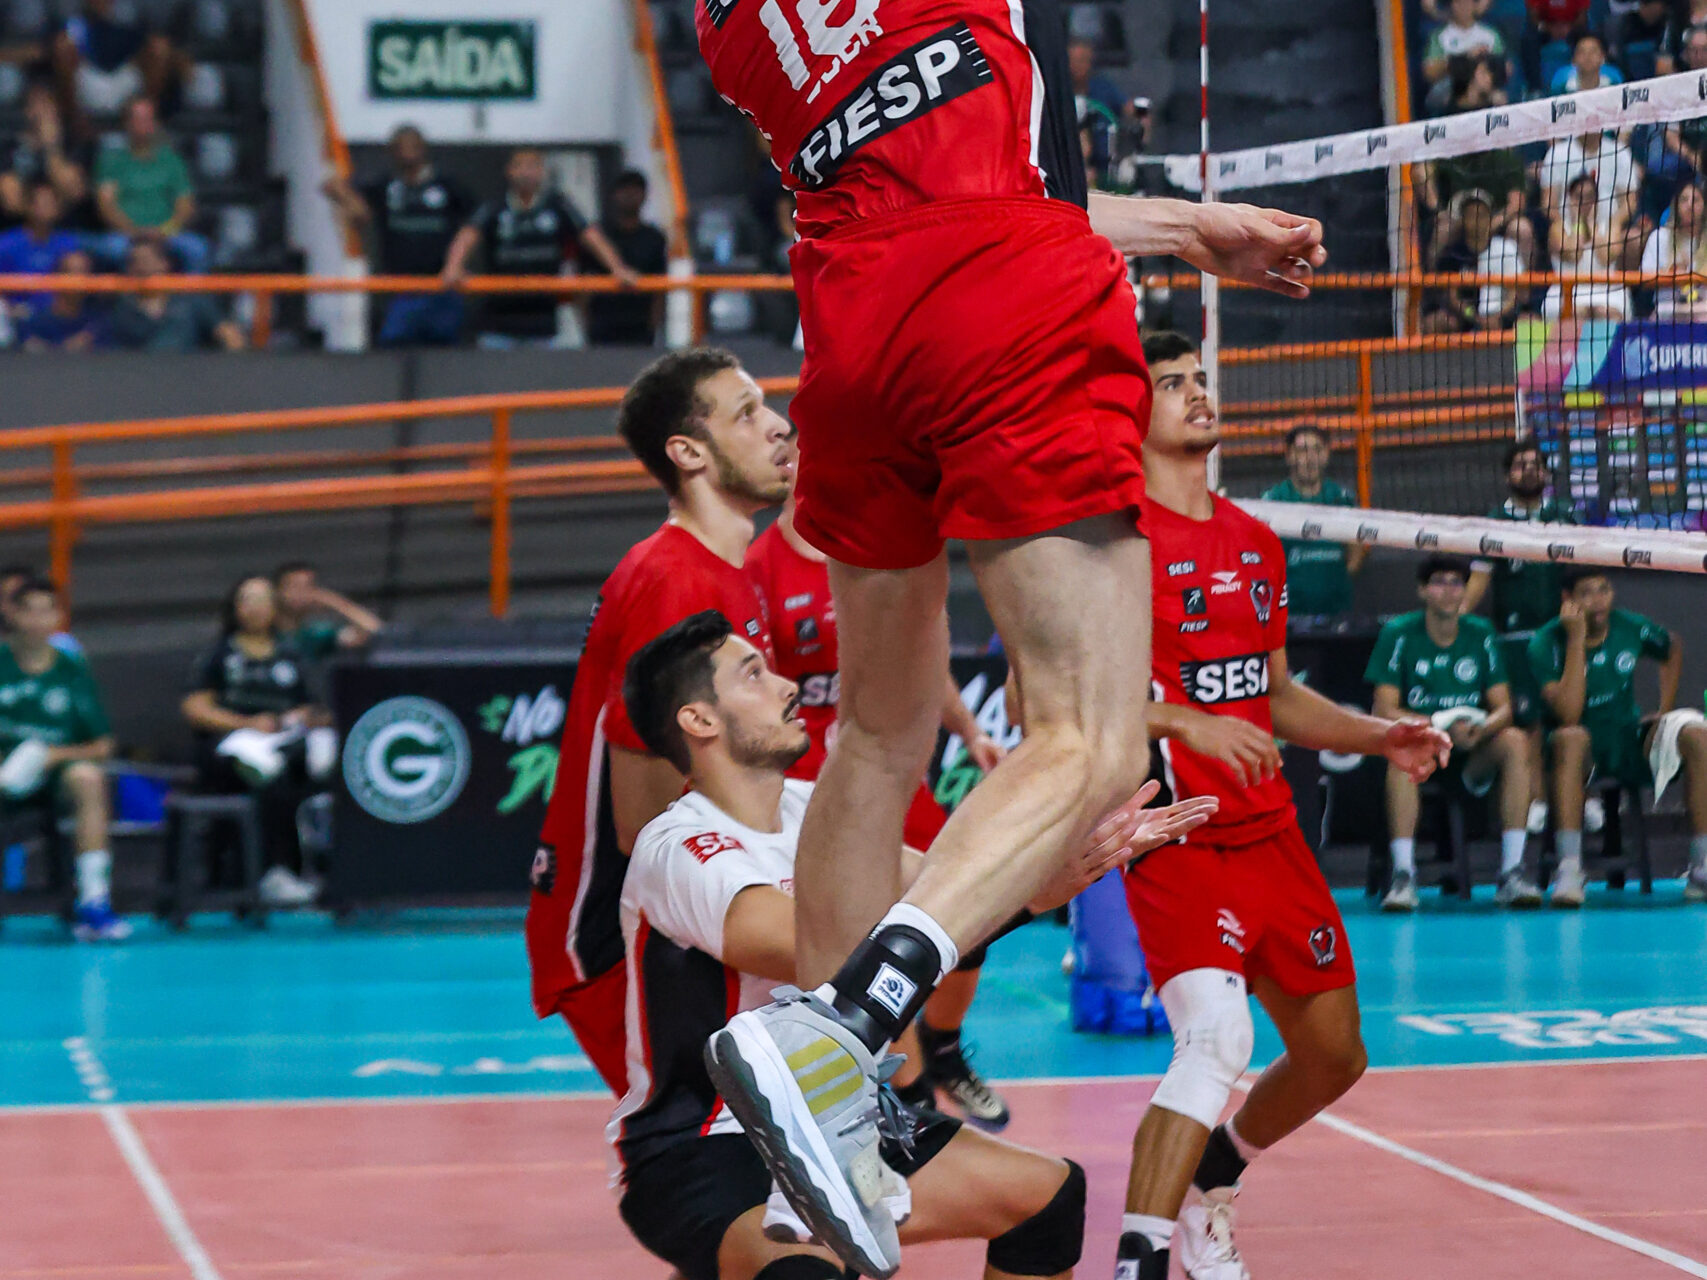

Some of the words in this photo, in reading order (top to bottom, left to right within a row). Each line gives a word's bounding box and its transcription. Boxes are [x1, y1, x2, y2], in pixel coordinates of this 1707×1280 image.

[377, 27, 526, 91] SAÍDA
[799, 38, 961, 185] FIESP
[1194, 657, 1269, 703] SESI
